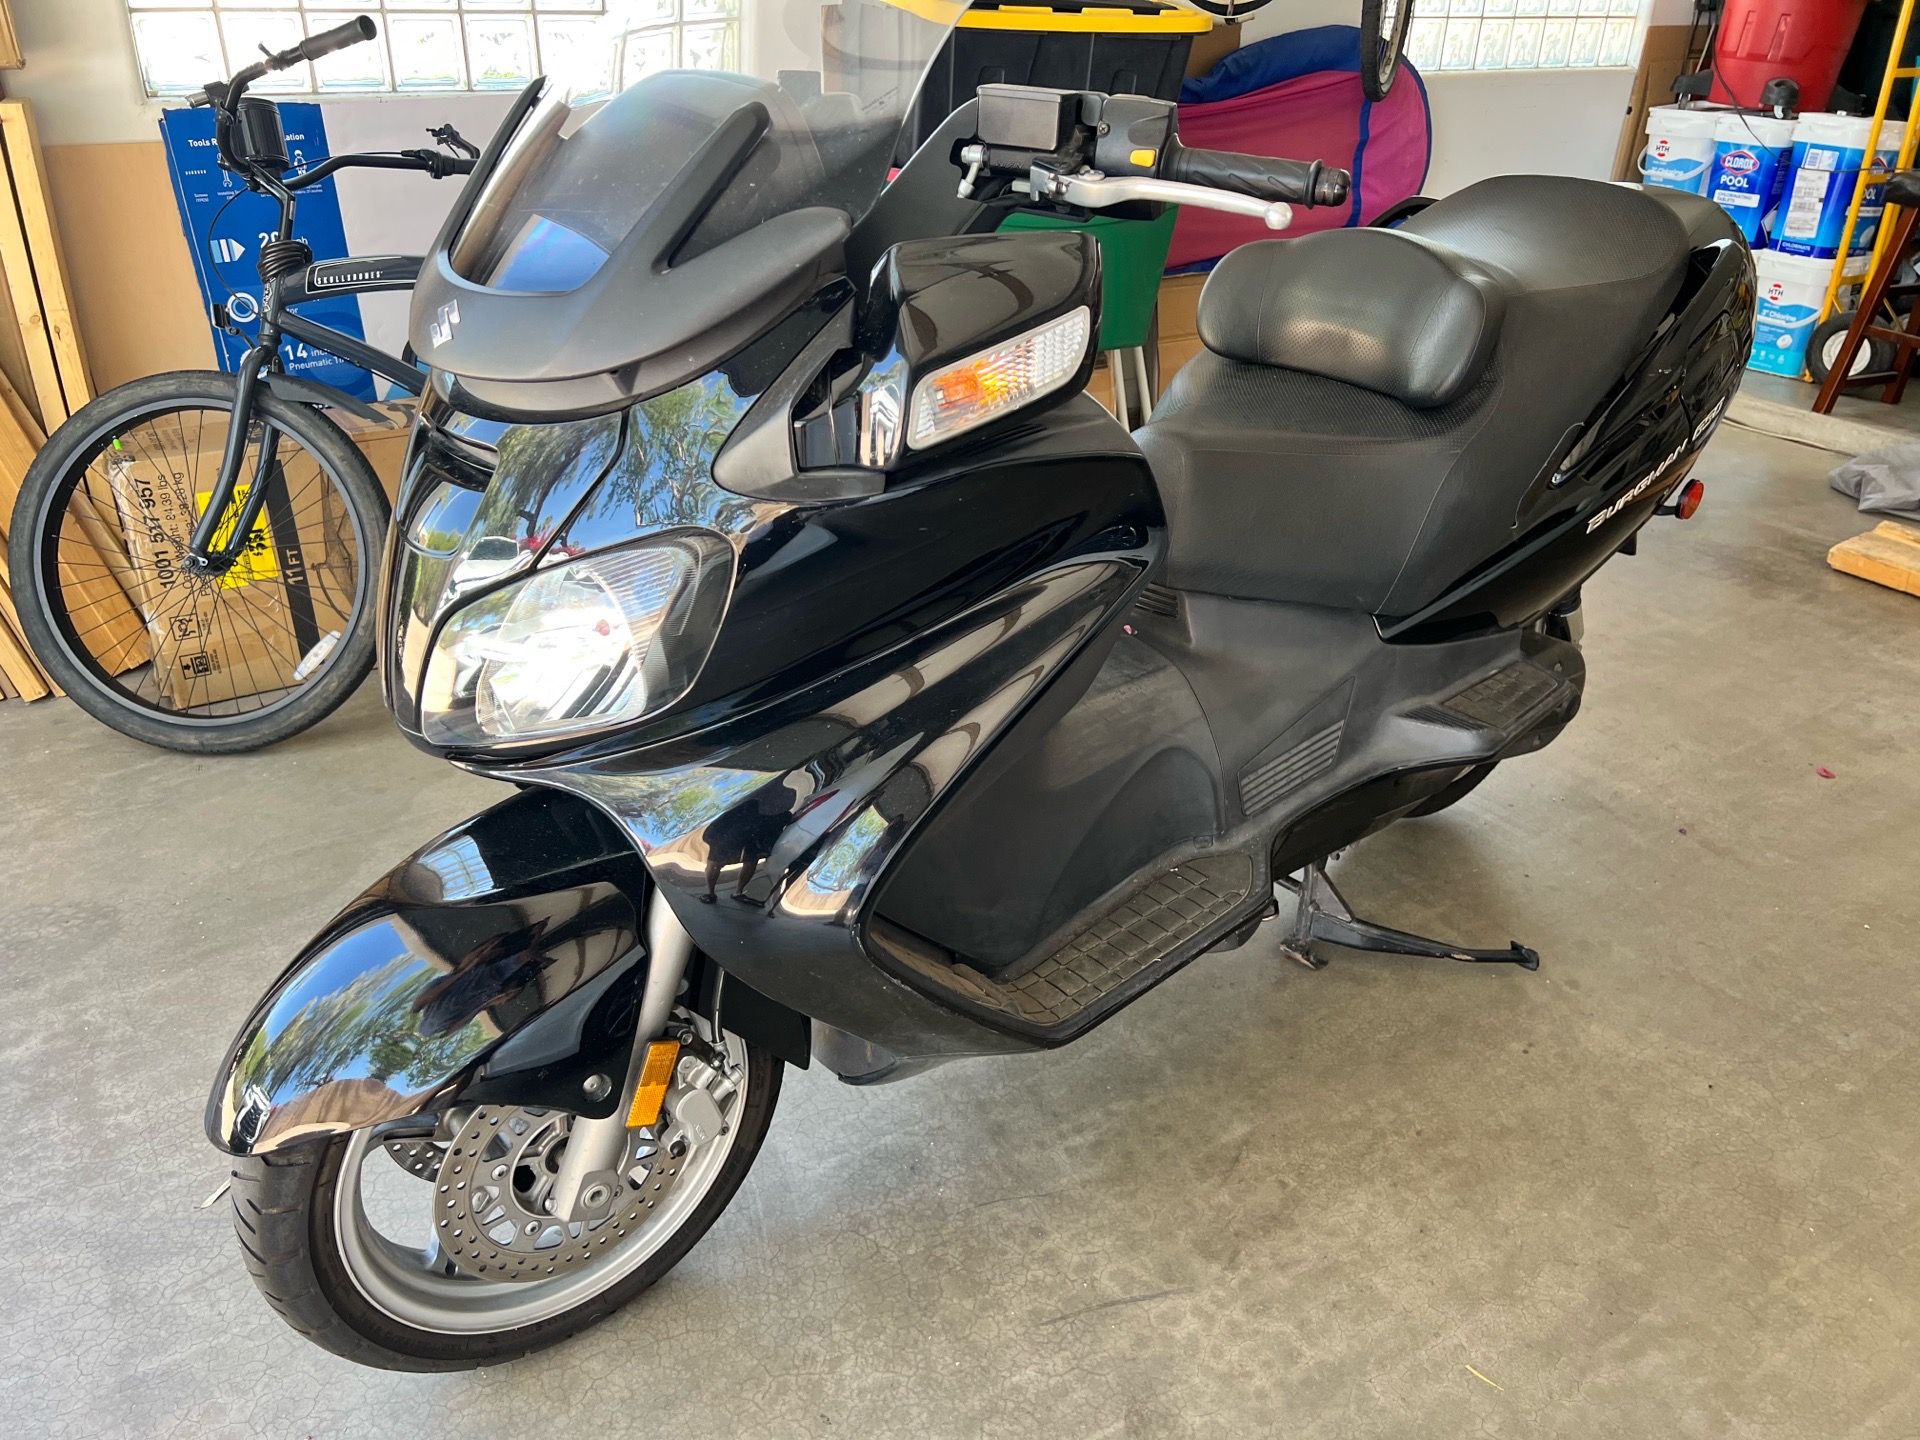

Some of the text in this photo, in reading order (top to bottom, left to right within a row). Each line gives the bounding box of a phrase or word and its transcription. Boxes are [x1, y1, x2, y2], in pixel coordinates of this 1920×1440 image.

[188, 138, 211, 148] Tools
[1724, 156, 1755, 170] CLOROX
[1720, 174, 1749, 188] POOL
[285, 343, 308, 360] 14
[289, 358, 333, 371] Pneumatic
[157, 473, 168, 491] lbs
[173, 471, 185, 487] kg
[1586, 437, 1689, 534] BURGMAN
[133, 477, 157, 510] 957
[151, 550, 176, 589] 1001
[285, 549, 304, 585] 11 FT
